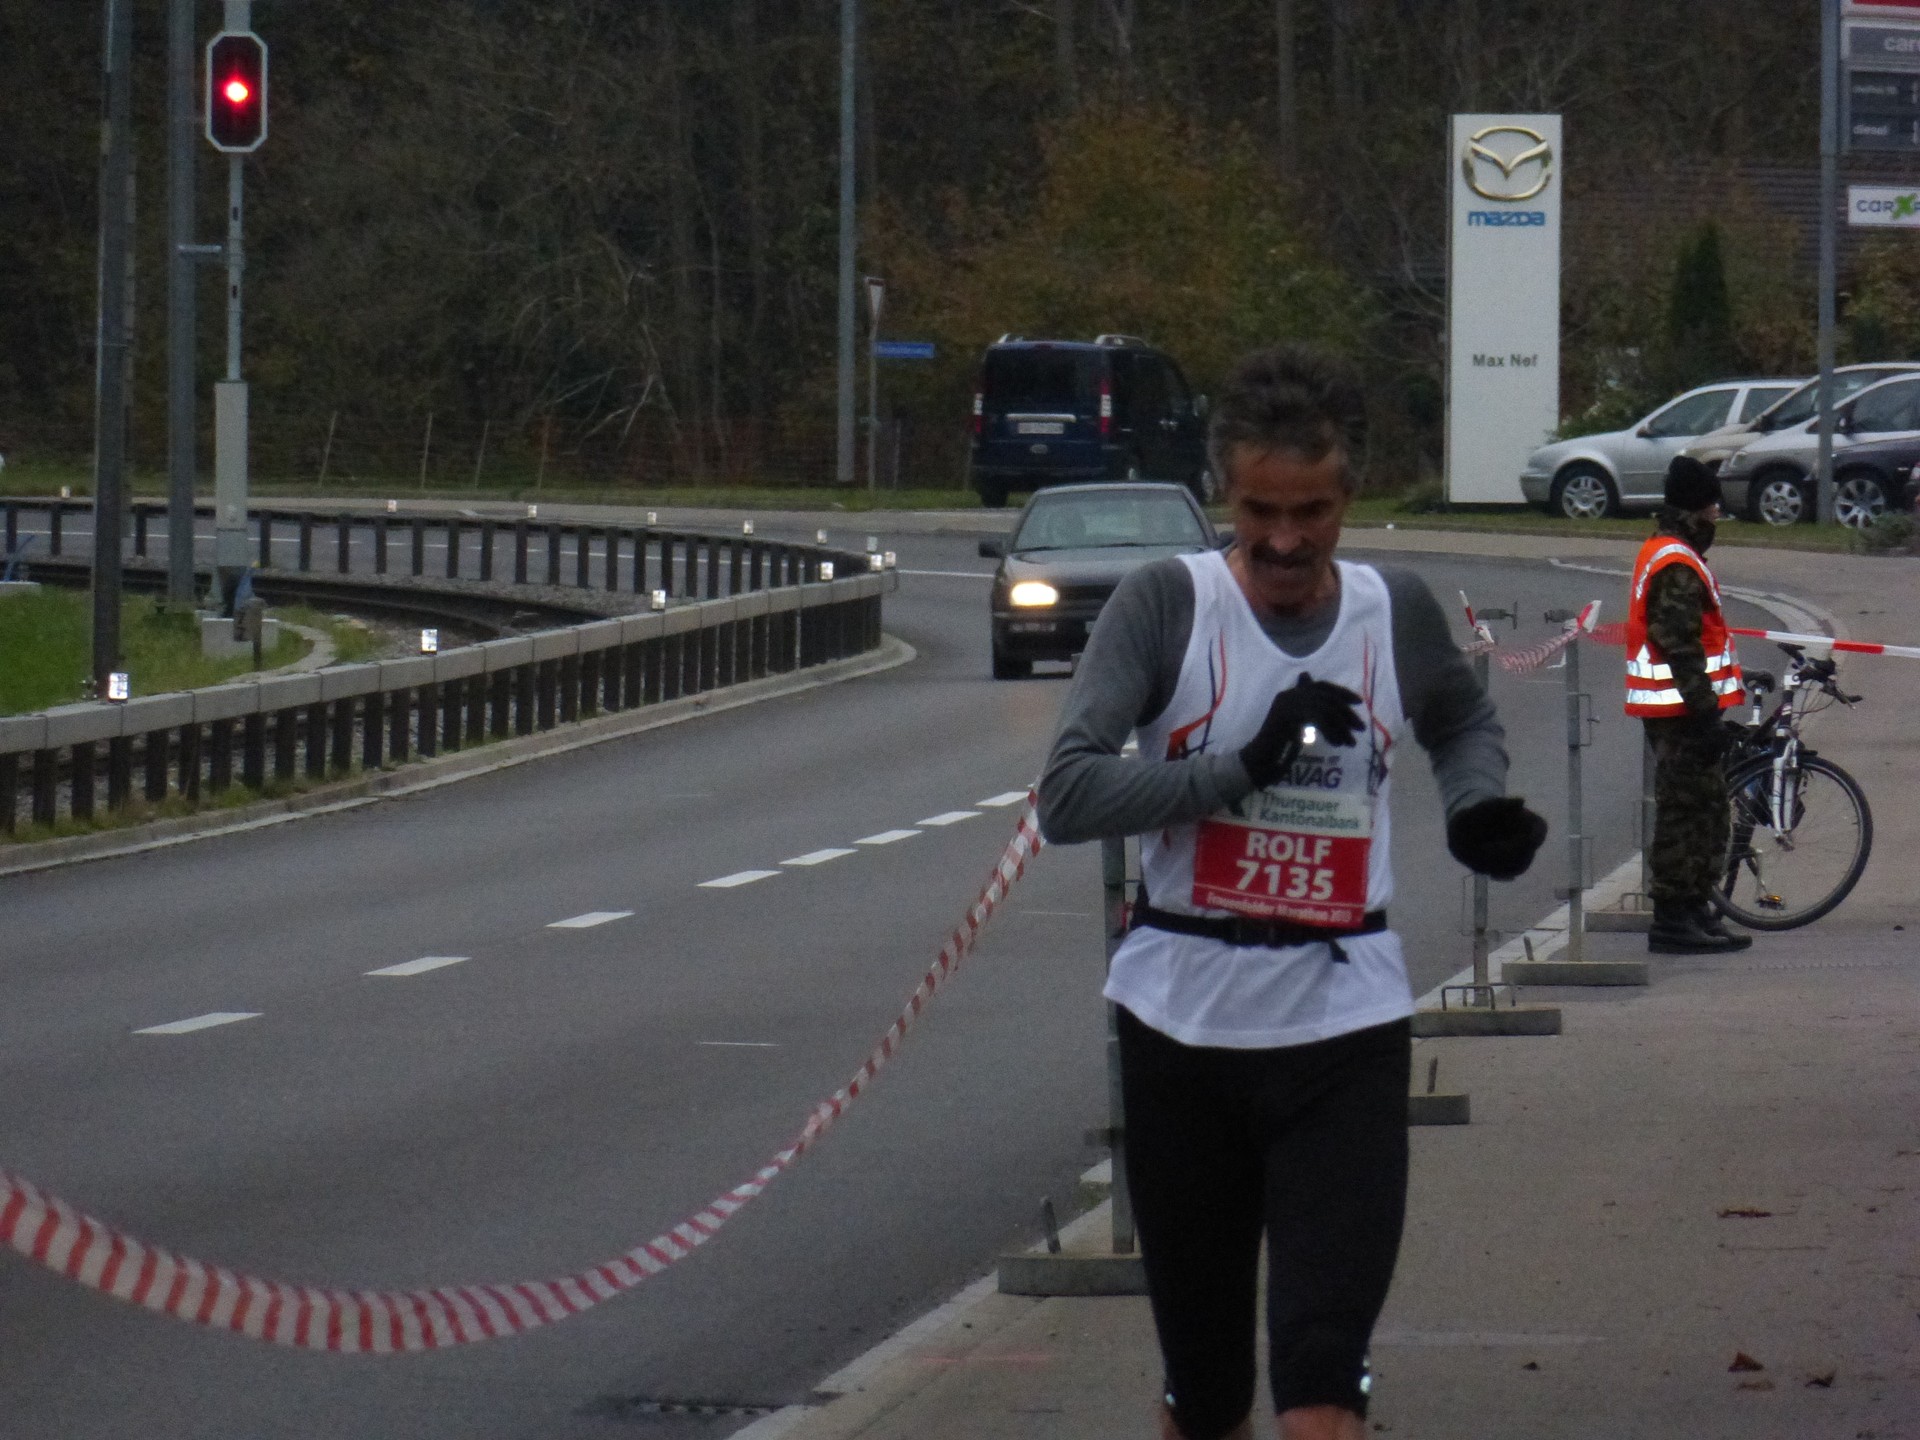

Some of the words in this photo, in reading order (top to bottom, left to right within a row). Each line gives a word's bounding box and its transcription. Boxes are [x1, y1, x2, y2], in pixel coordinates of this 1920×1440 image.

[1467, 211, 1546, 227] mazda
[1473, 354, 1504, 367] Max
[1510, 353, 1538, 368] Nef
[1246, 831, 1333, 866] ROLF
[1236, 859, 1335, 901] 7135
